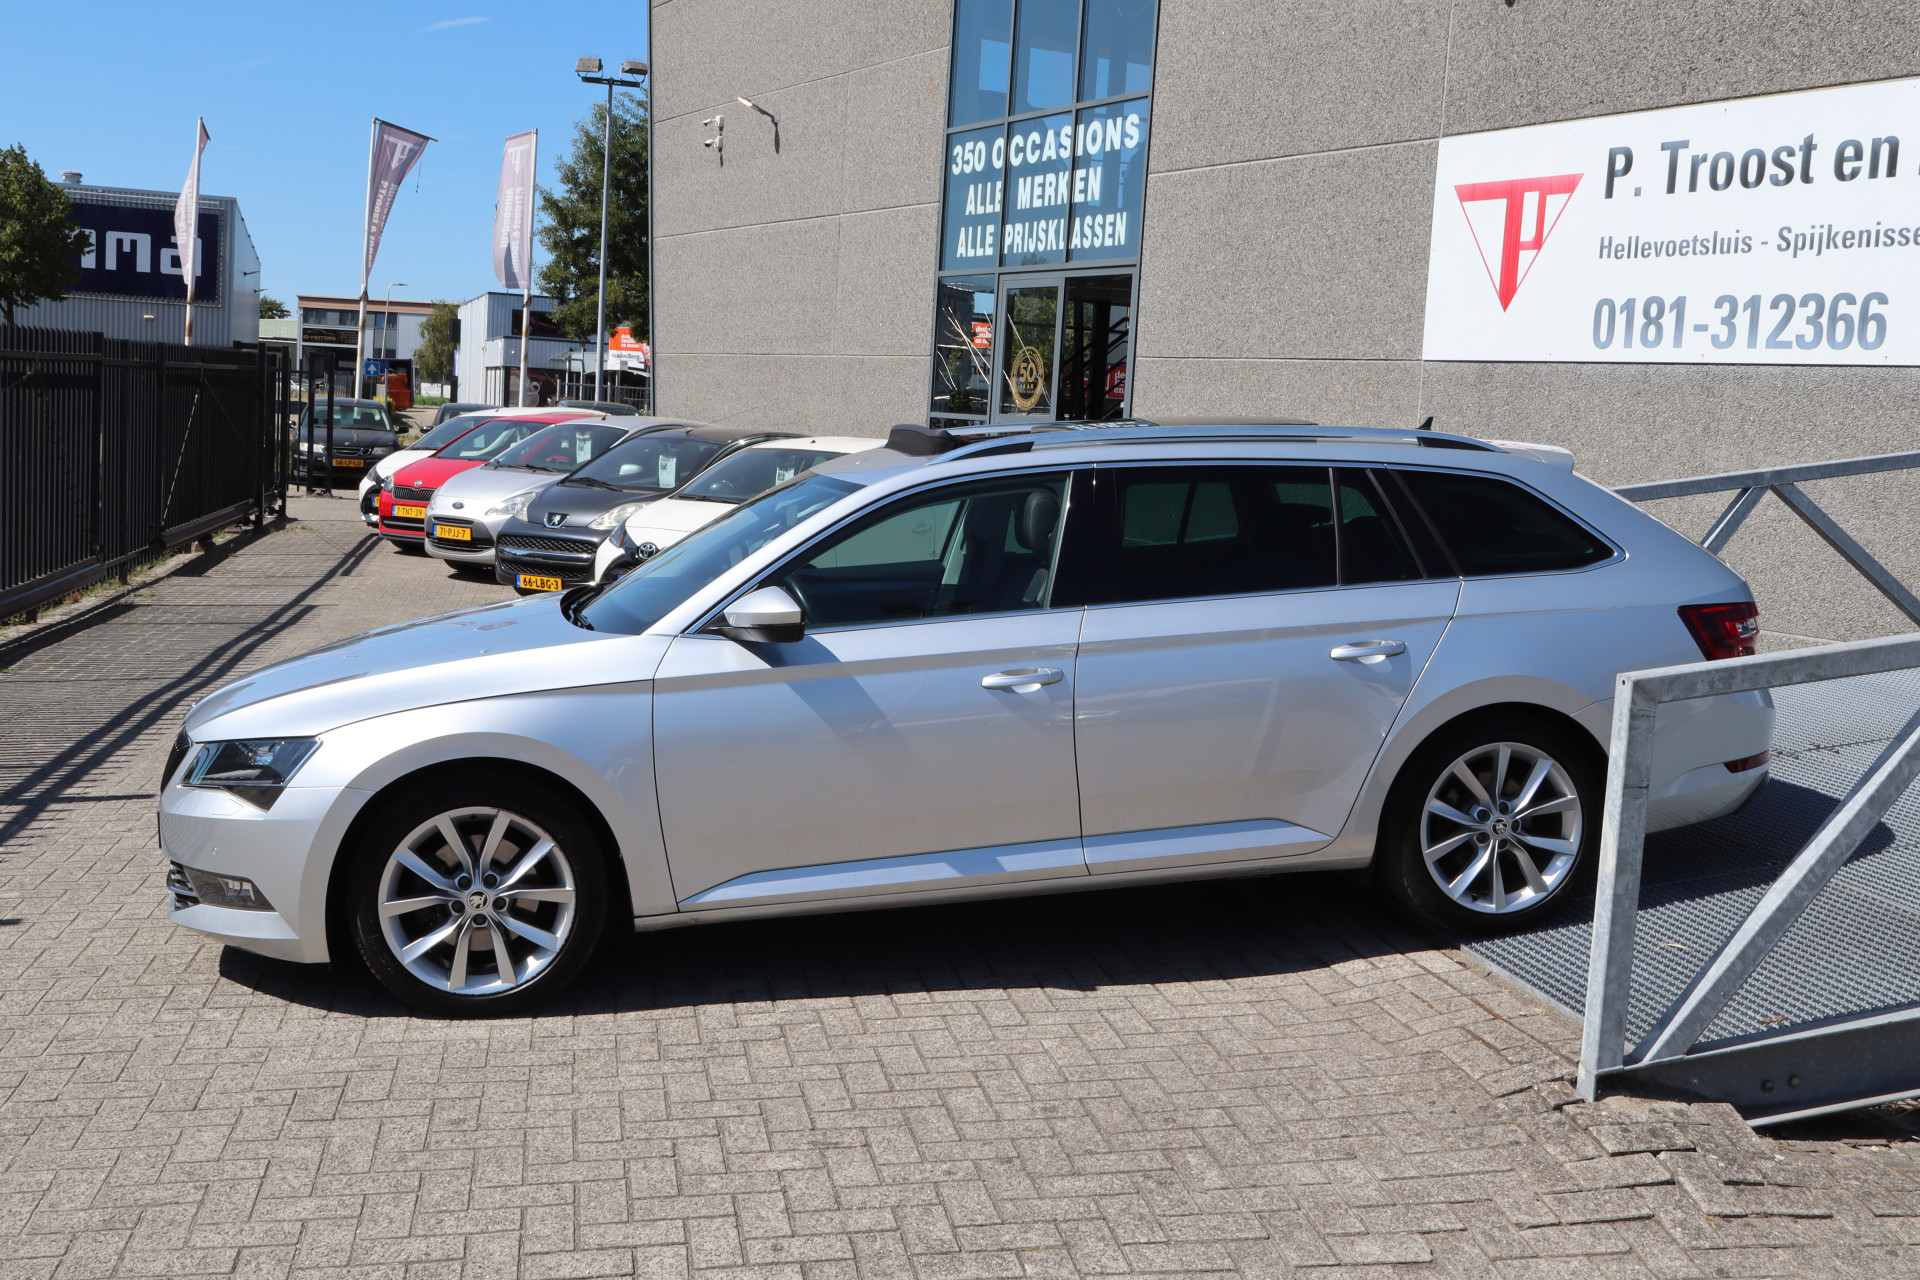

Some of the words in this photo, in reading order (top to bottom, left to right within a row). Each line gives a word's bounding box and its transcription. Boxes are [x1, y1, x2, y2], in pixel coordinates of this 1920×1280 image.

[952, 140, 986, 176] 350
[992, 113, 1140, 169] OCCASIONS
[1603, 146, 1642, 199] P.
[1660, 133, 1818, 195] Troost
[1833, 135, 1900, 182] en
[965, 180, 1002, 216] ALLE
[1017, 166, 1102, 210] MERKEN
[956, 224, 995, 258] ALLE
[1003, 211, 1127, 255] PRIJSKLASSEN
[1598, 229, 1753, 260] Hellevoetsluis
[1592, 291, 1889, 350] 0181-312366
[1020, 362, 1036, 383] 50
[396, 505, 423, 517] 7-TNT-39
[440, 526, 466, 538] 71-PJJ-7
[523, 576, 559, 590] 66-LBG-3
